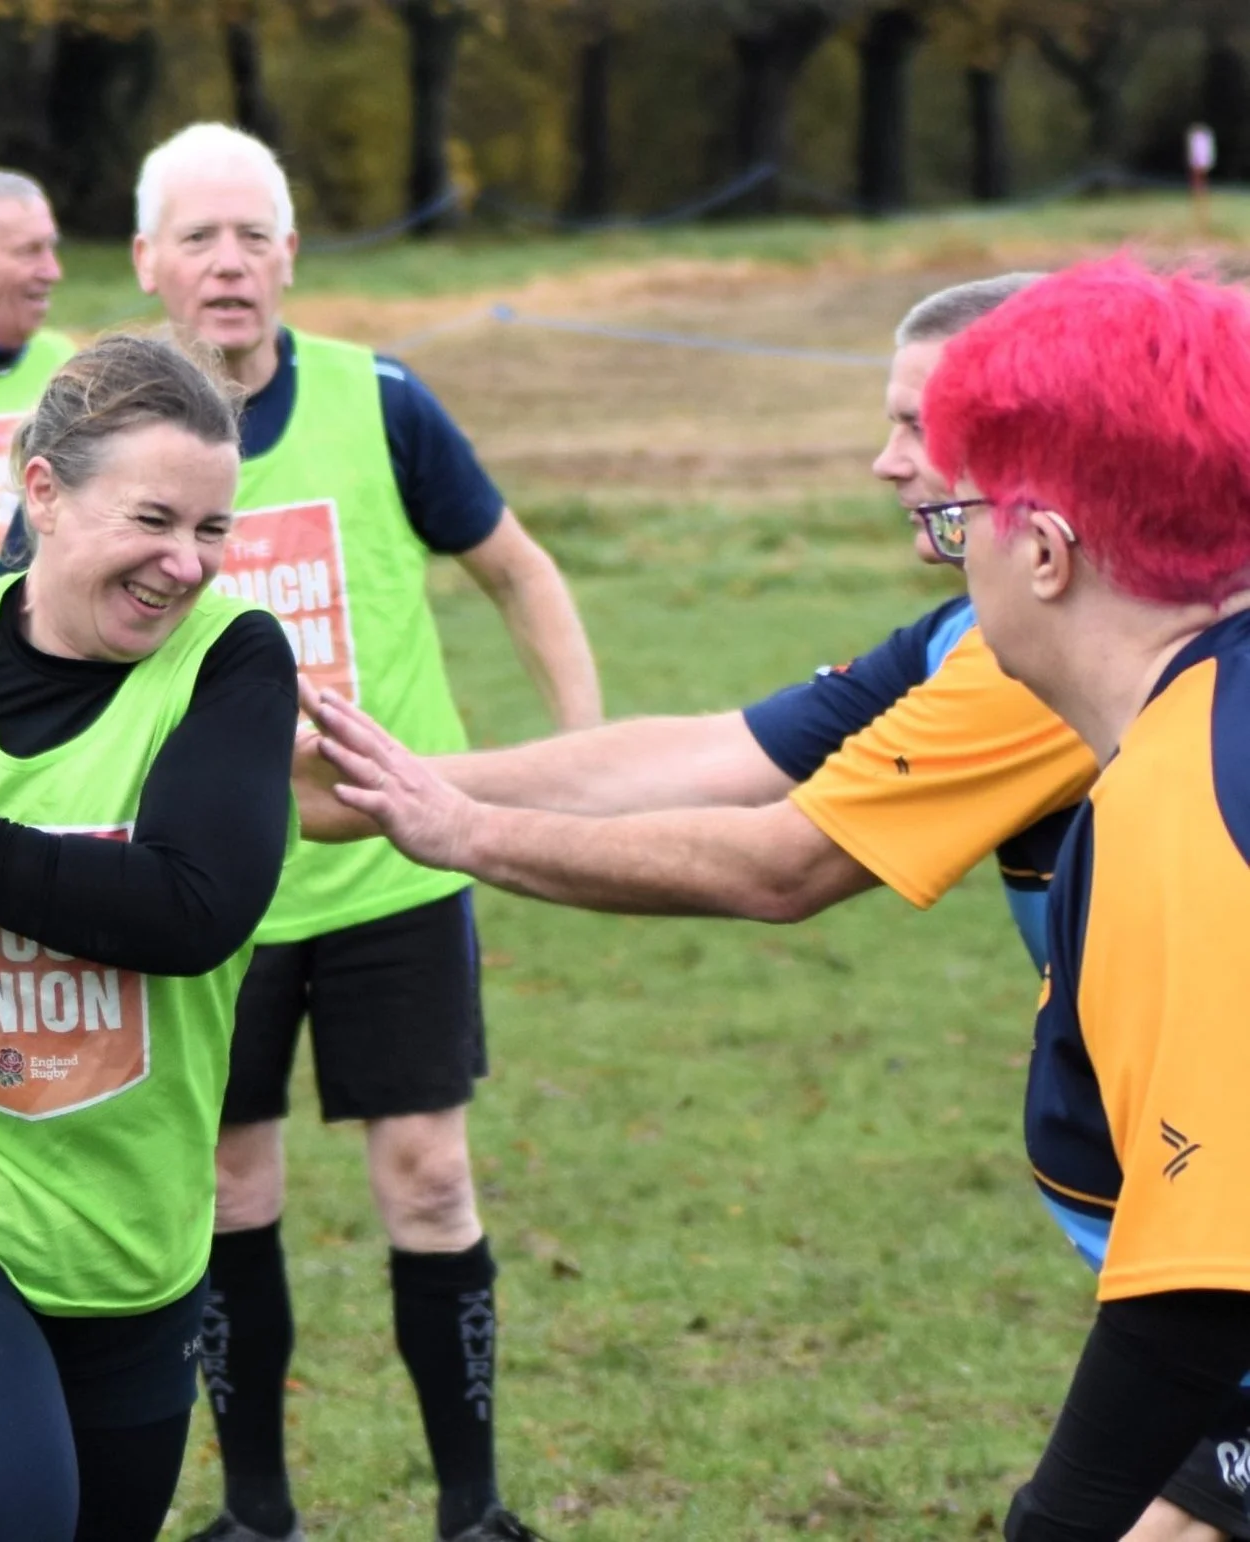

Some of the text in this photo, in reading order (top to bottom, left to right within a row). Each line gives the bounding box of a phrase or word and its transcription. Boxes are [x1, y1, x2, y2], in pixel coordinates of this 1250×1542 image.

[231, 539, 271, 560] THE
[210, 560, 331, 615] OUCH
[30, 1054, 79, 1068] England
[30, 1067, 68, 1081] Rugby
